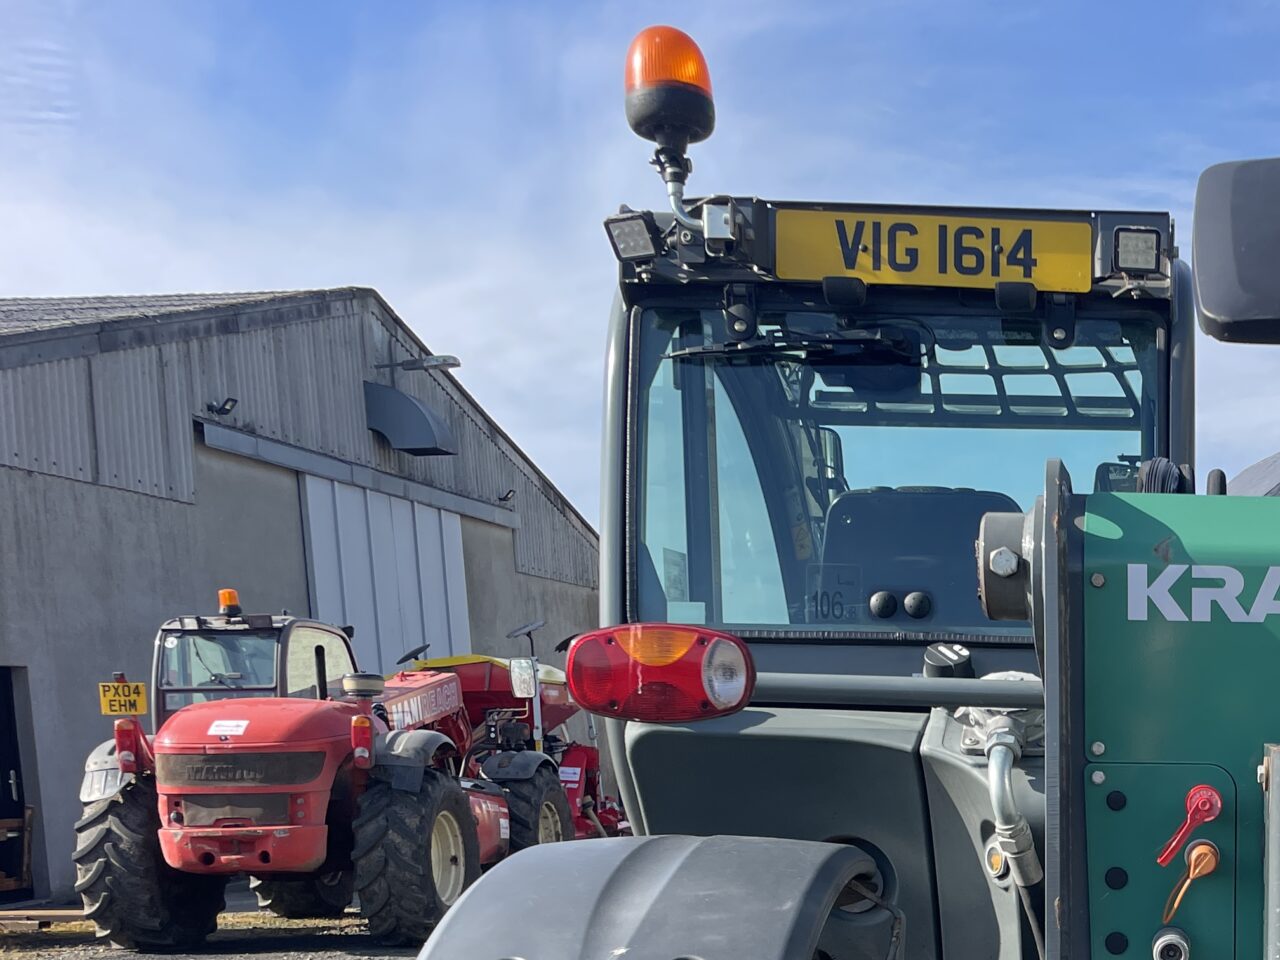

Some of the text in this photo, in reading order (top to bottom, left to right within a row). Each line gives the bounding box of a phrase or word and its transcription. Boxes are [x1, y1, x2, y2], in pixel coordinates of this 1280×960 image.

[835, 219, 1038, 279] VIG 1614
[812, 590, 844, 619] 106
[101, 684, 141, 698] PX04
[109, 699, 138, 712] EHM
